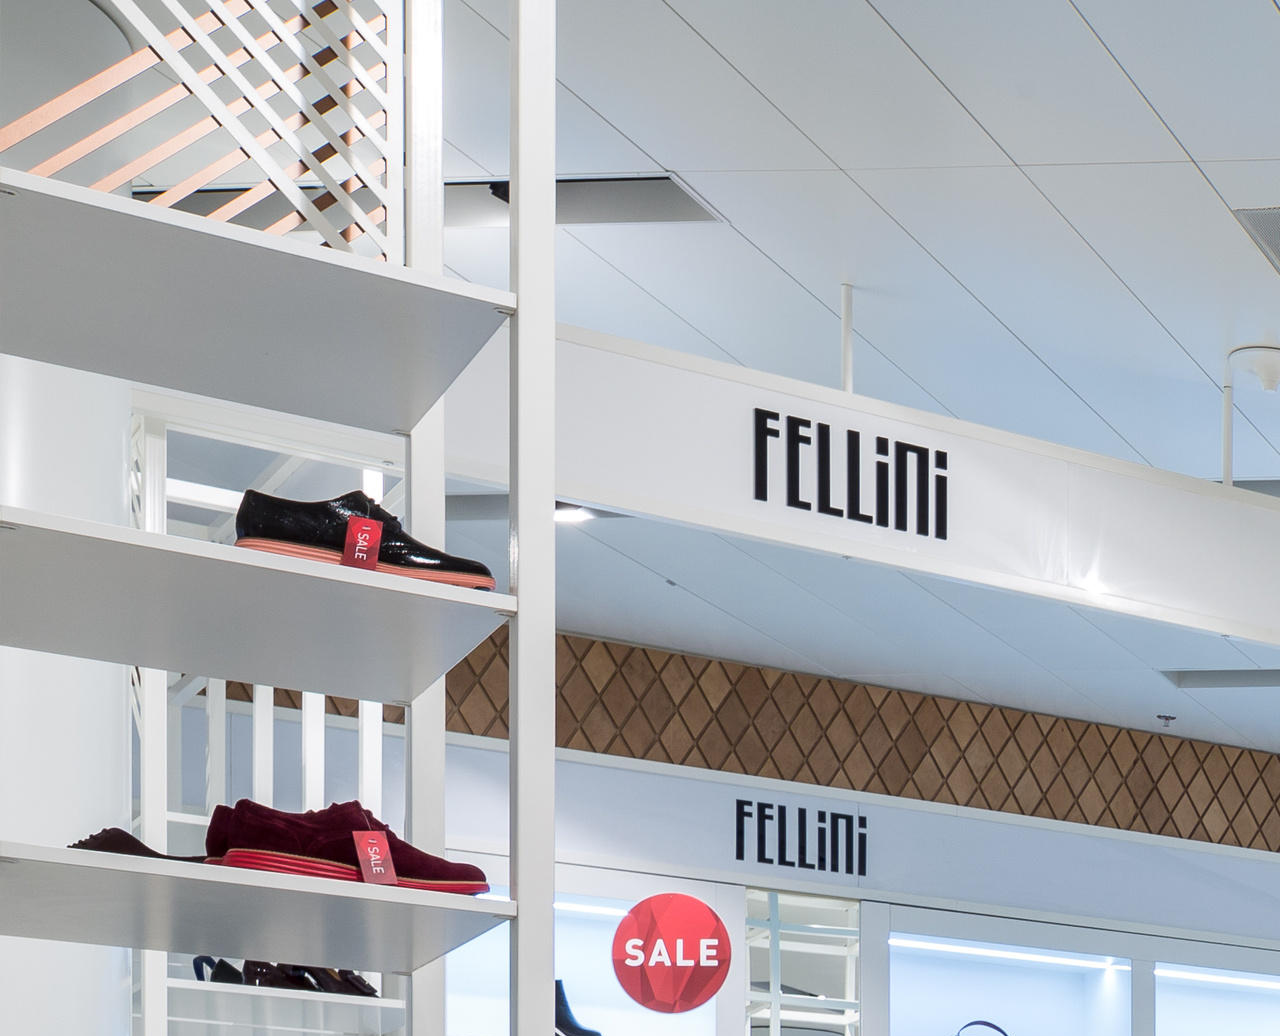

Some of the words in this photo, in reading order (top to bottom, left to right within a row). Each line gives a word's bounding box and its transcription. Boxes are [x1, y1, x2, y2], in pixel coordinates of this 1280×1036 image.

[354, 531, 370, 561] SALE
[367, 846, 385, 874] SALE
[624, 938, 719, 967] SALE
